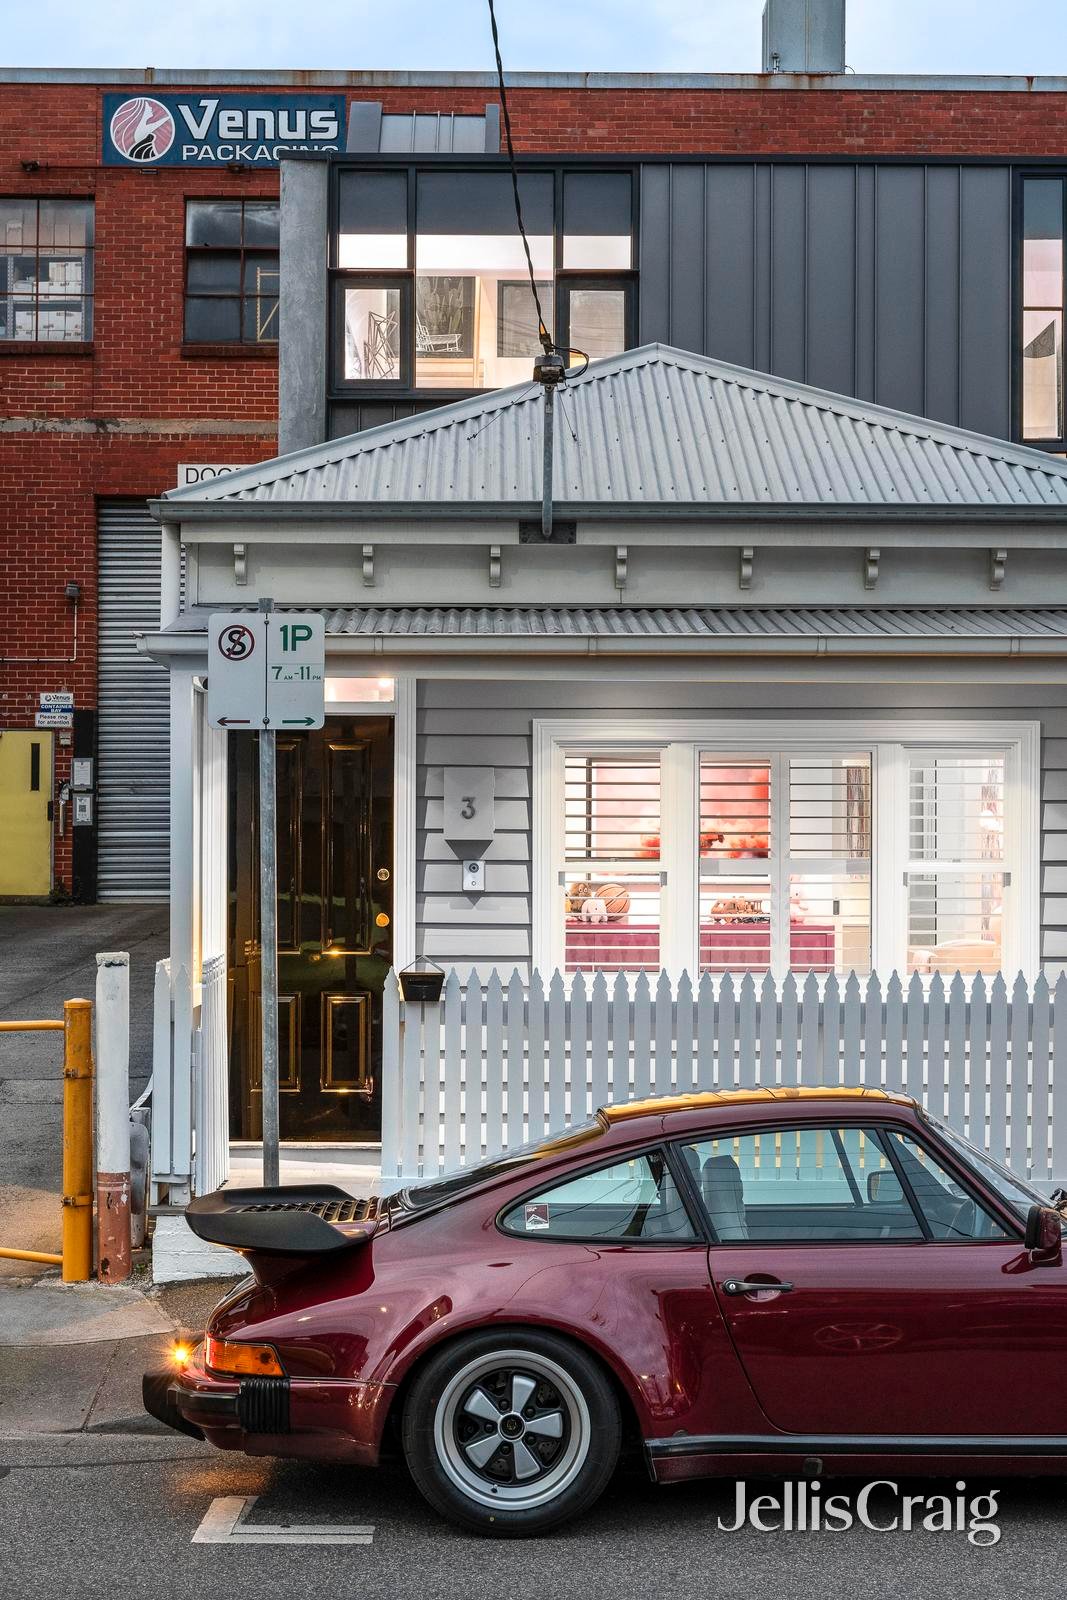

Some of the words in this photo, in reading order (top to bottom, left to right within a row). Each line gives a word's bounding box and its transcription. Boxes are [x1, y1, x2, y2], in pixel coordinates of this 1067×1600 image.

[177, 98, 339, 140] Venus
[182, 144, 339, 161] PACKA
[185, 467, 241, 484] DO
[280, 624, 313, 652] 1P
[461, 795, 476, 820] 3
